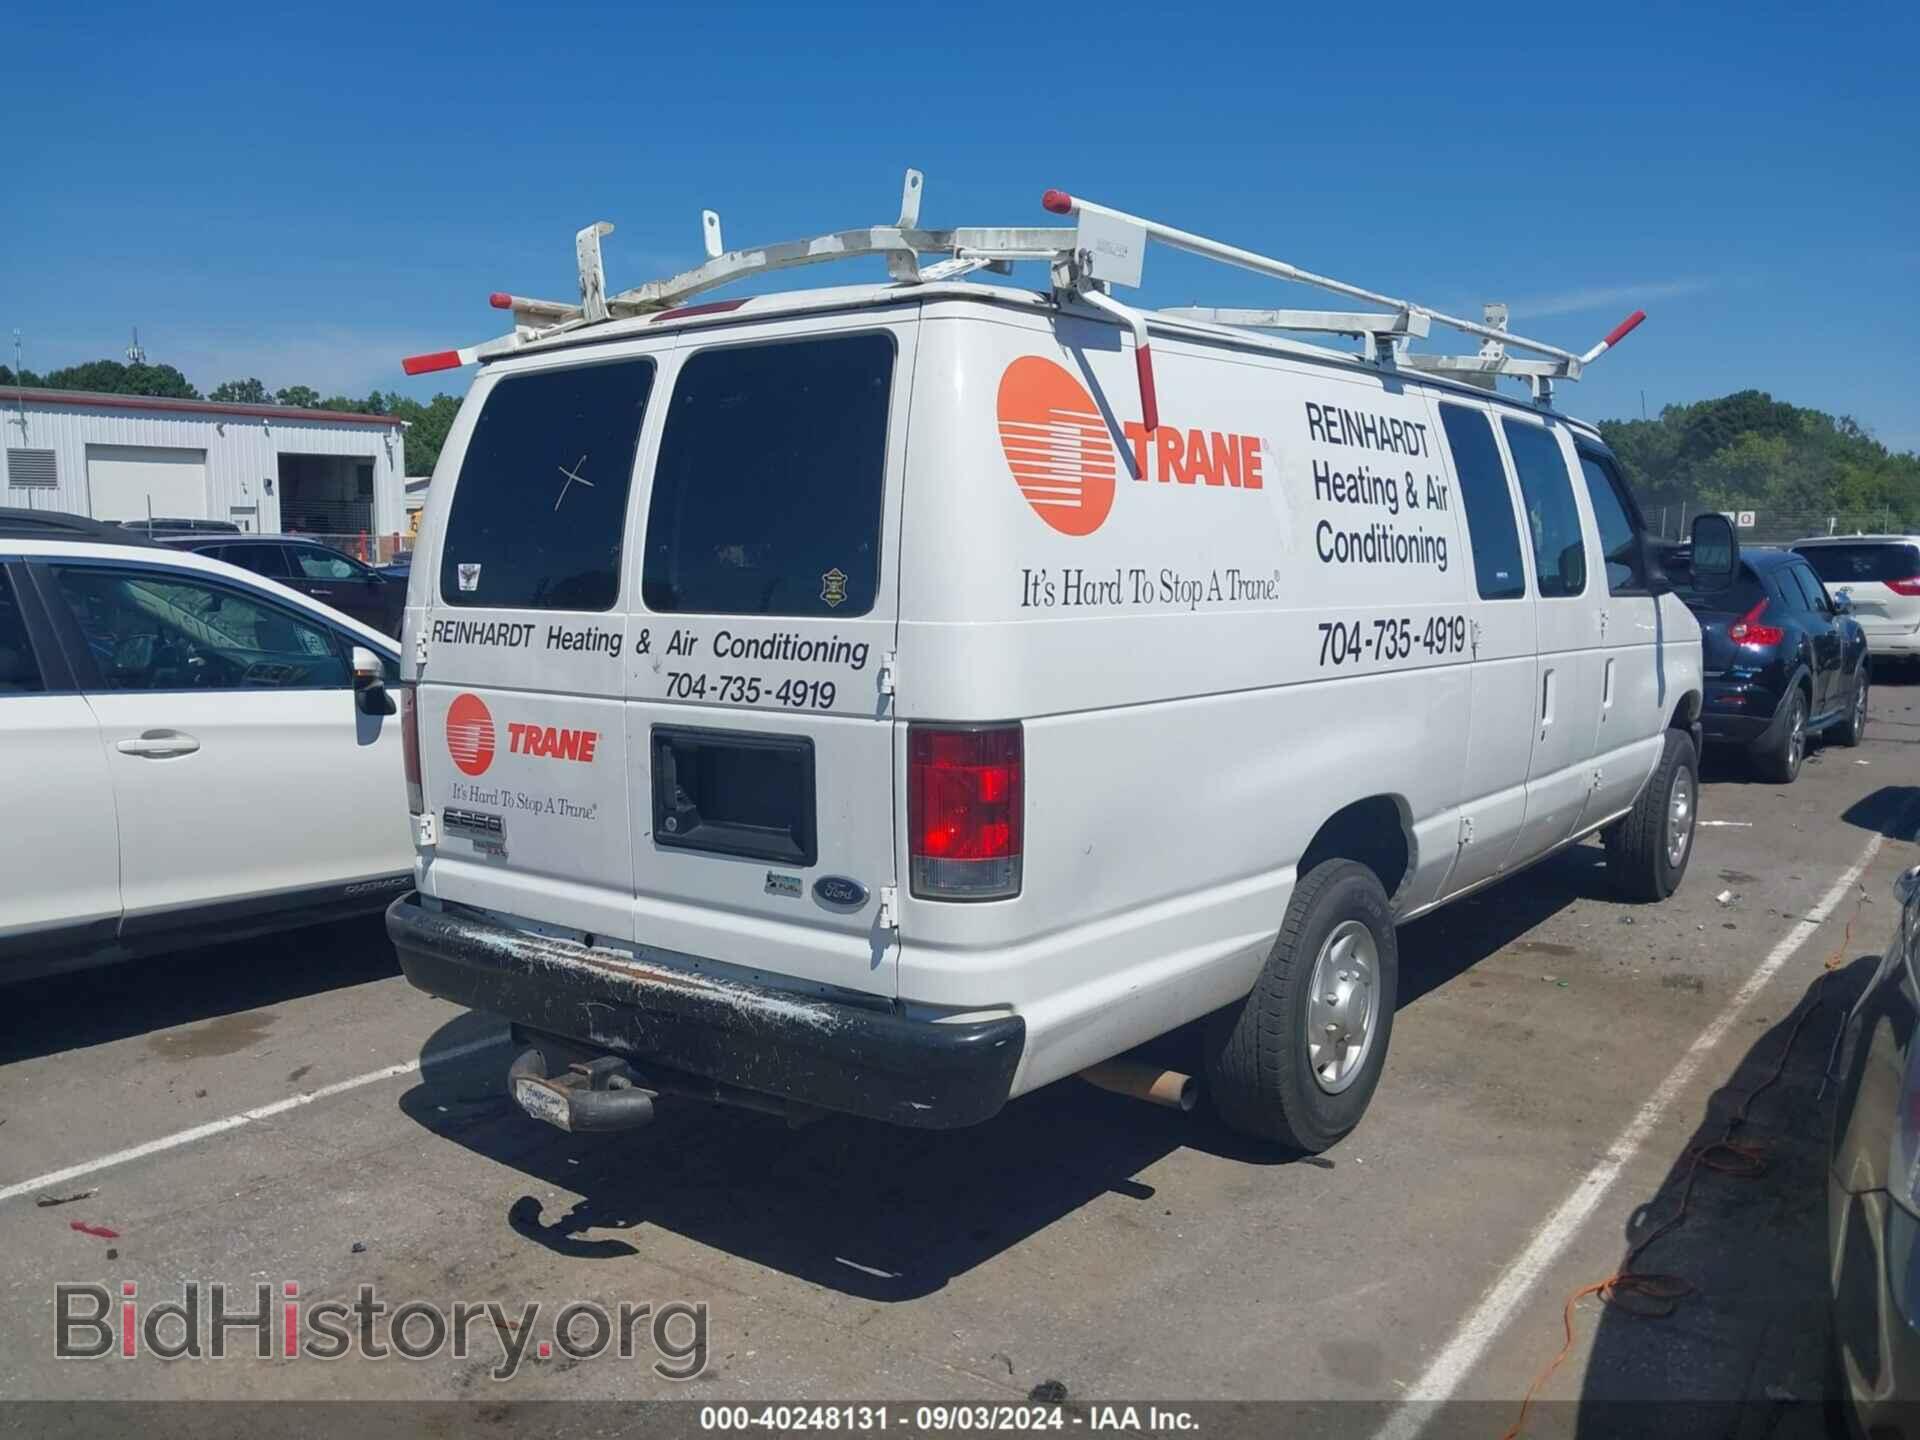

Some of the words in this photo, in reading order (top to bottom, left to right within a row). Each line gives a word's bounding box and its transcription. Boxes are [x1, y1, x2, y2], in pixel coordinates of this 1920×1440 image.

[1123, 421, 1263, 489] TRANE
[1305, 401, 1429, 458] REINHARDT
[1312, 459, 1400, 515] Heating
[1404, 471, 1420, 509] &
[1426, 474, 1449, 512] Air
[1315, 519, 1449, 573] Conditioning
[1021, 568, 1056, 607] It's
[1061, 568, 1124, 606] Hard
[1128, 568, 1154, 604] To
[1159, 568, 1202, 611] Stop
[1207, 569, 1223, 601] A
[431, 620, 535, 648] REINHARDT
[547, 626, 623, 658] Heating
[635, 628, 651, 654] &
[666, 630, 698, 656] Air
[713, 630, 869, 670] Conditioning
[1318, 615, 1466, 667] 704-735-4919
[666, 672, 836, 709] 704-735-4919
[508, 723, 598, 763] TRANE
[469, 785, 499, 806] Hard
[501, 791, 515, 809] To
[517, 793, 542, 816] Stop
[544, 799, 555, 814] A
